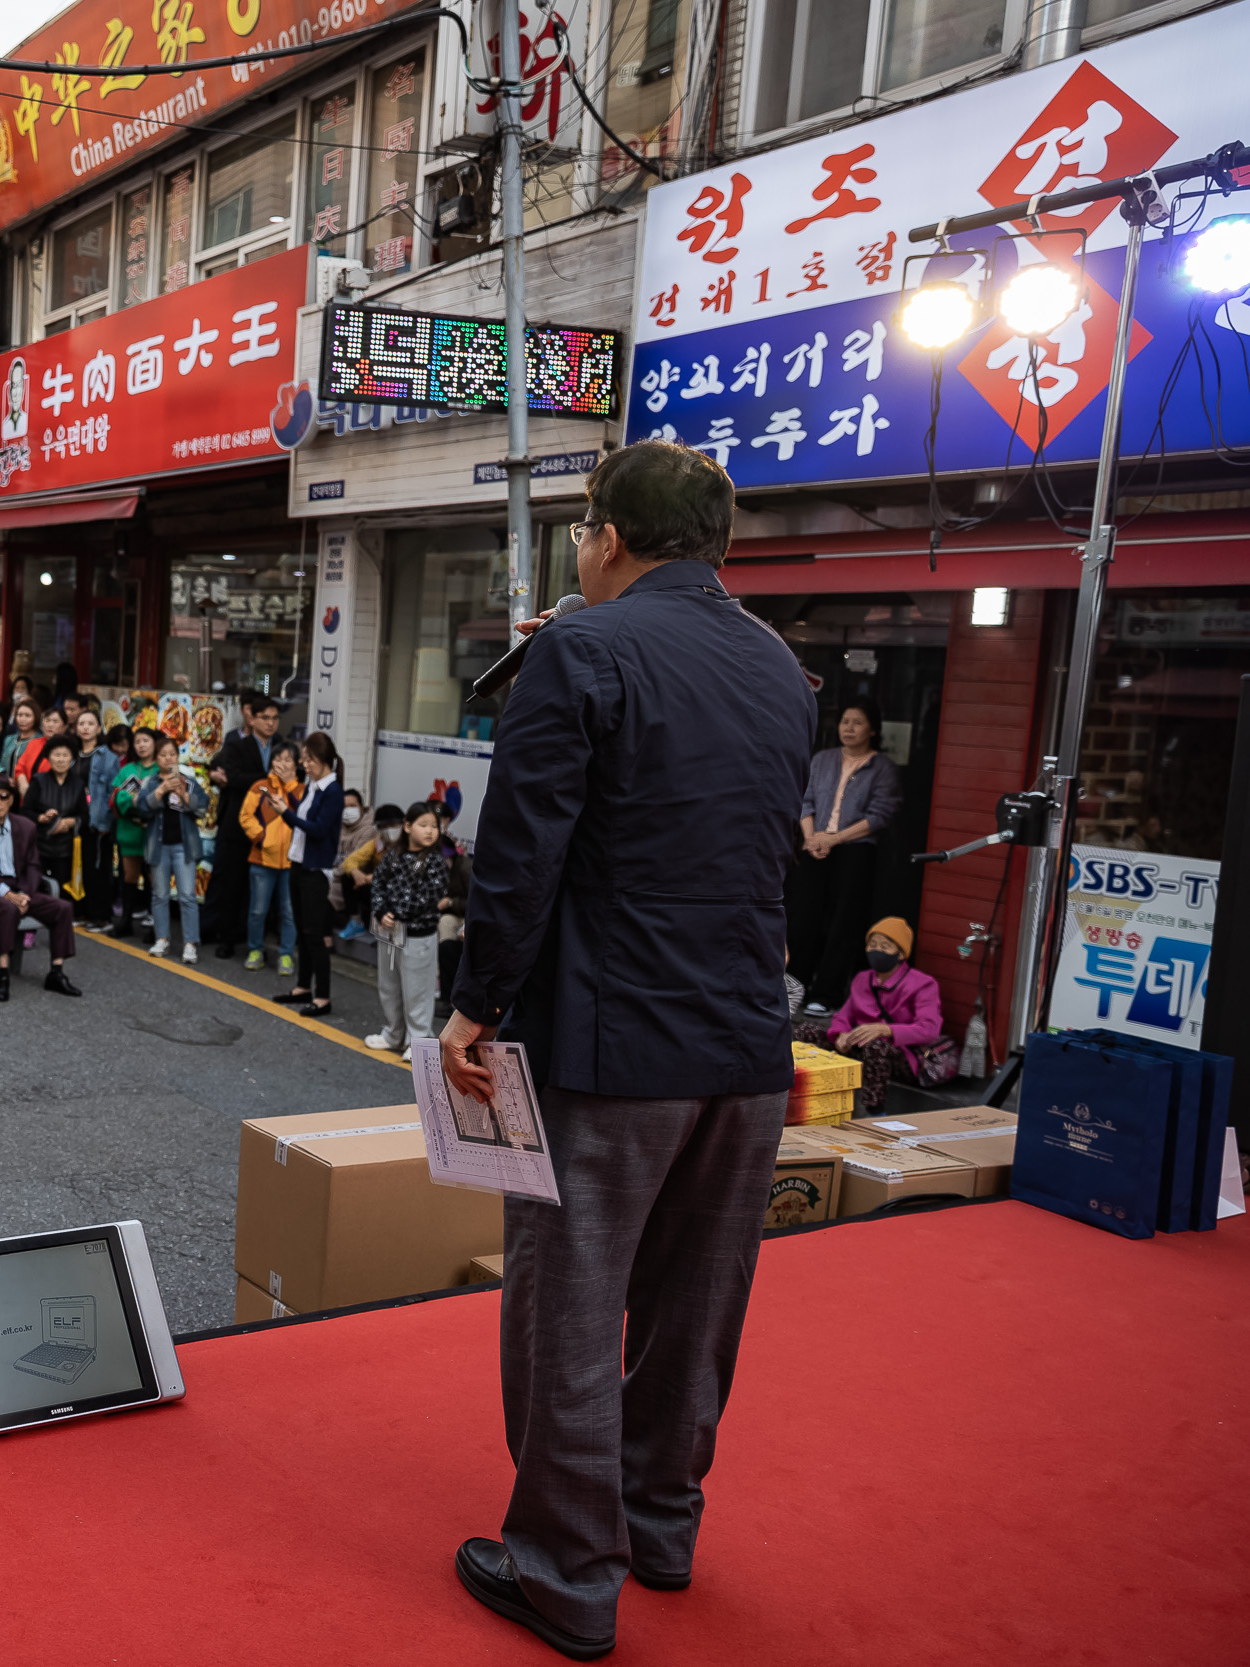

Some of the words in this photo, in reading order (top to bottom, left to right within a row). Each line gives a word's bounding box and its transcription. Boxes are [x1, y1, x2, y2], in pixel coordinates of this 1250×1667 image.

[70, 136, 114, 177] China
[112, 75, 208, 153] Restaurant
[40, 301, 281, 418] 牛肉面大王
[1073, 943, 1208, 1019] 투데
[772, 1179, 811, 1195] HARBIN
[54, 1317, 81, 1326] ELF
[50, 1405, 74, 1415] SAMSUNG
